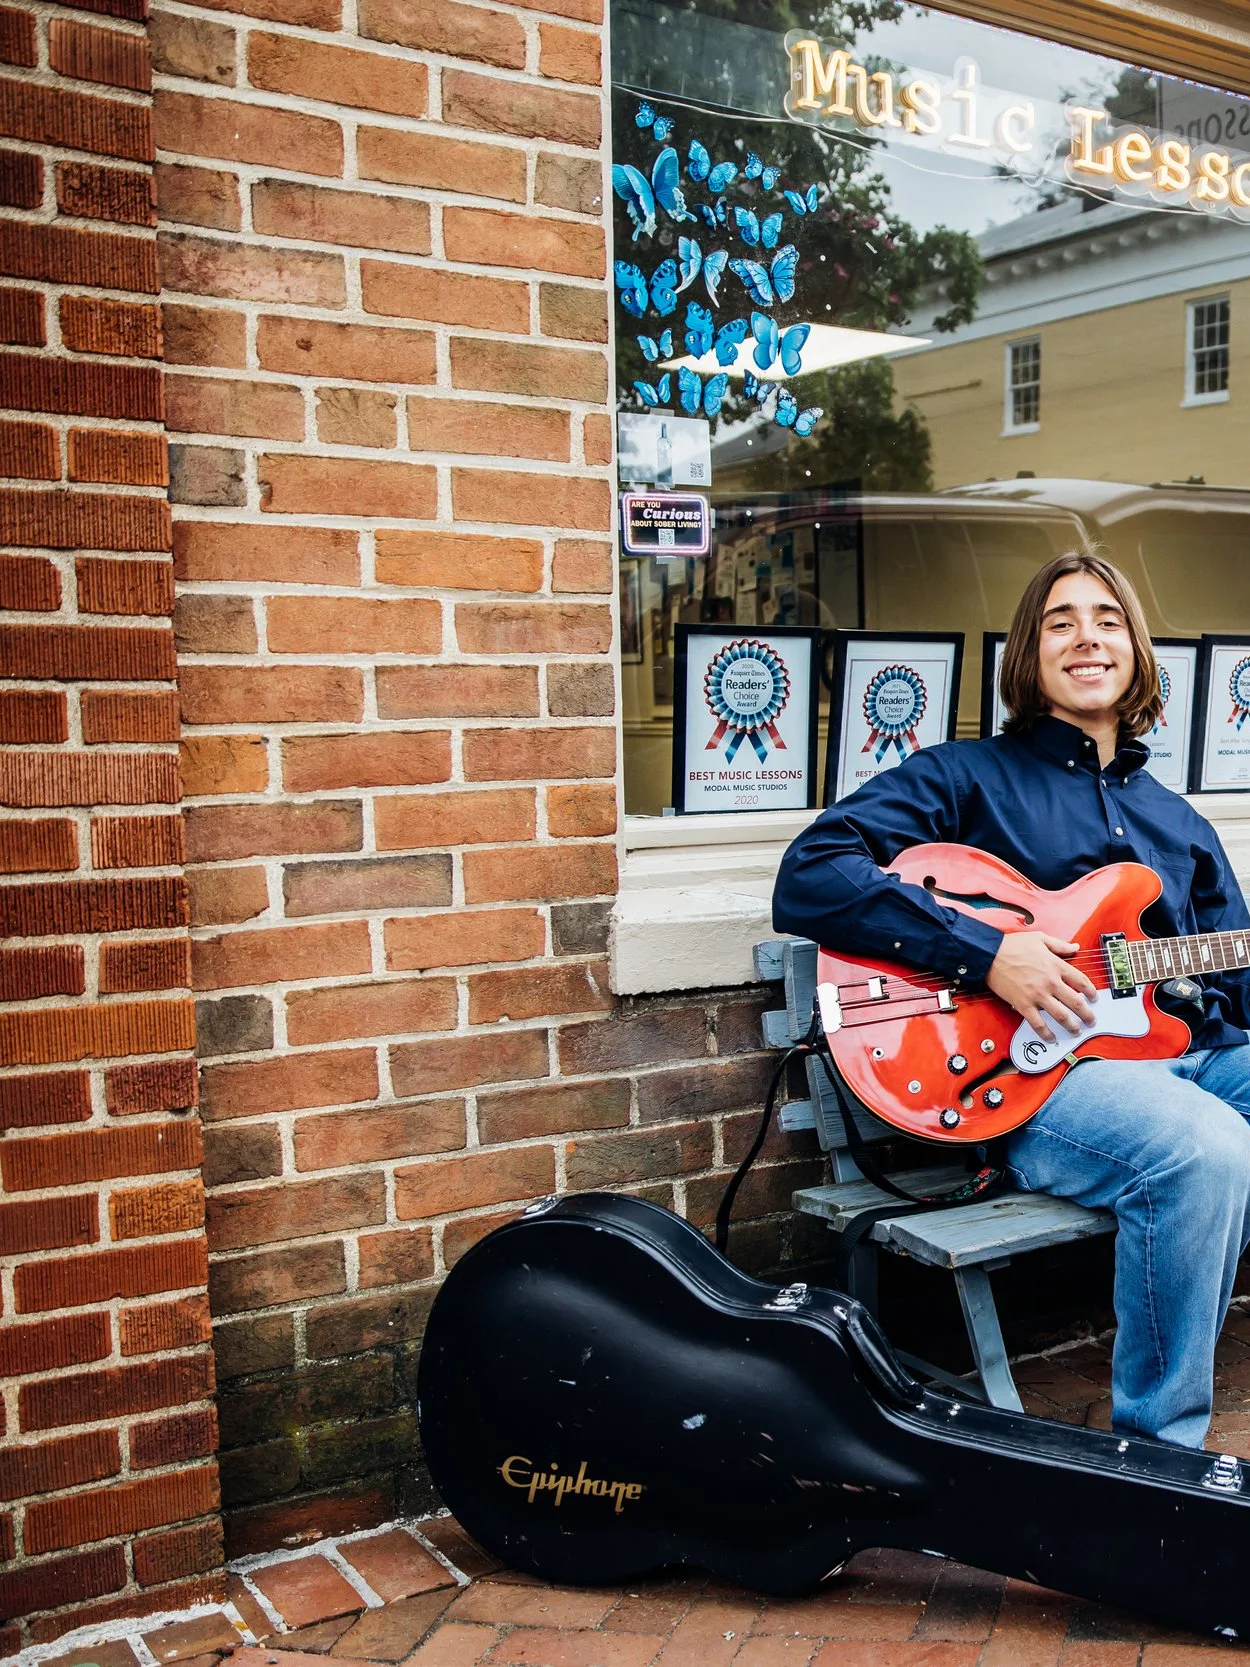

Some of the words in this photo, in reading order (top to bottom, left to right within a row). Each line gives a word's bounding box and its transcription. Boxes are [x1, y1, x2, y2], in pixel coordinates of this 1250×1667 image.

[790, 39, 1035, 152] Music
[646, 501, 661, 509] YOU
[642, 508, 702, 520] Curious
[630, 520, 652, 528] ABOUT
[654, 520, 676, 528] SOBER
[733, 692, 760, 700] Choice
[689, 771, 715, 780] BEST
[718, 771, 752, 780] MUSIC
[755, 770, 803, 780] LESSONS
[855, 770, 873, 778] BEST
[734, 795, 759, 805] 2020
[496, 1455, 644, 1515] Epiphone
